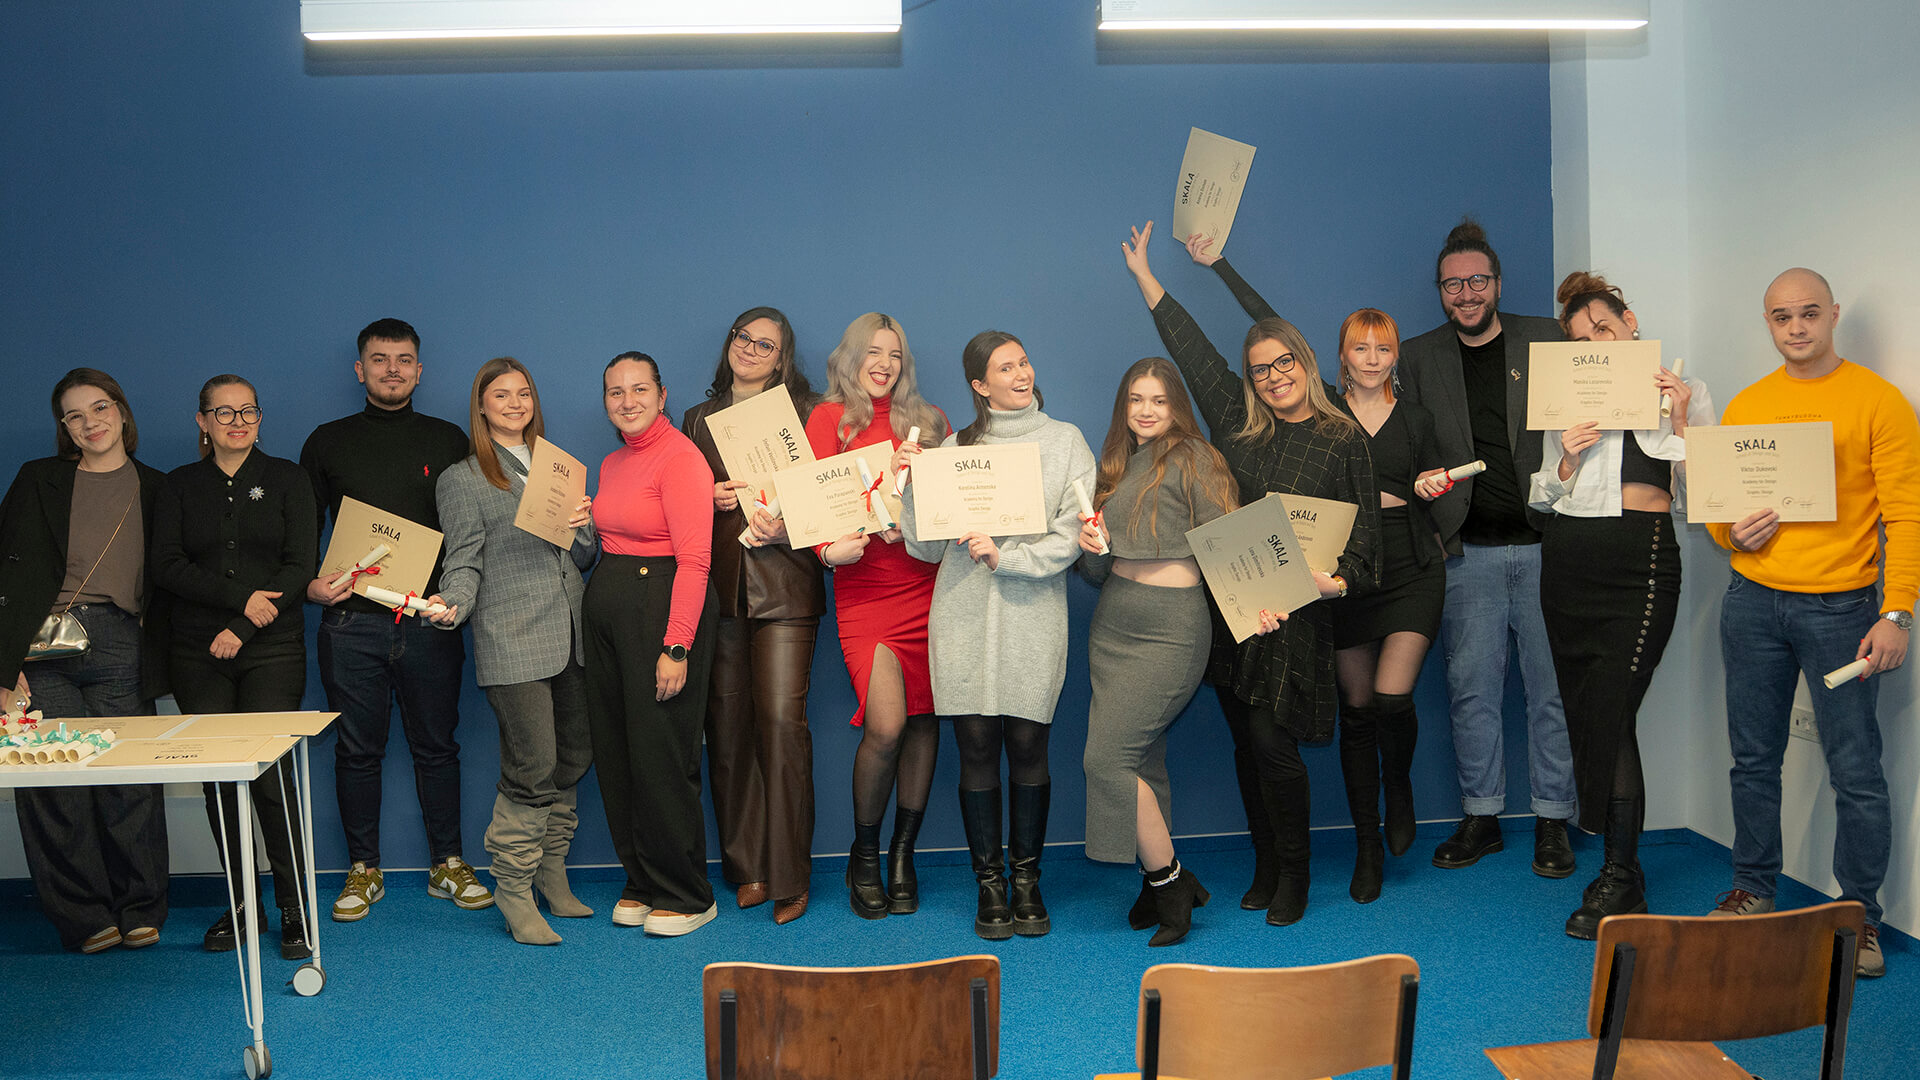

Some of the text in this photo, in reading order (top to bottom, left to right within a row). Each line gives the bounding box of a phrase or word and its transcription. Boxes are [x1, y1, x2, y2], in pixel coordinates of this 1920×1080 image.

[1182, 172, 1195, 205] SKALA
[1572, 354, 1609, 367] SKALA
[778, 427, 801, 463] SKALA
[1734, 439, 1777, 453] SKALA
[553, 462, 570, 479] SKALA
[954, 459, 991, 472] SKALA
[815, 466, 851, 484] SKALA
[1290, 509, 1317, 523] SKALA
[371, 523, 401, 542] SKALA
[1267, 534, 1289, 567] SKALA
